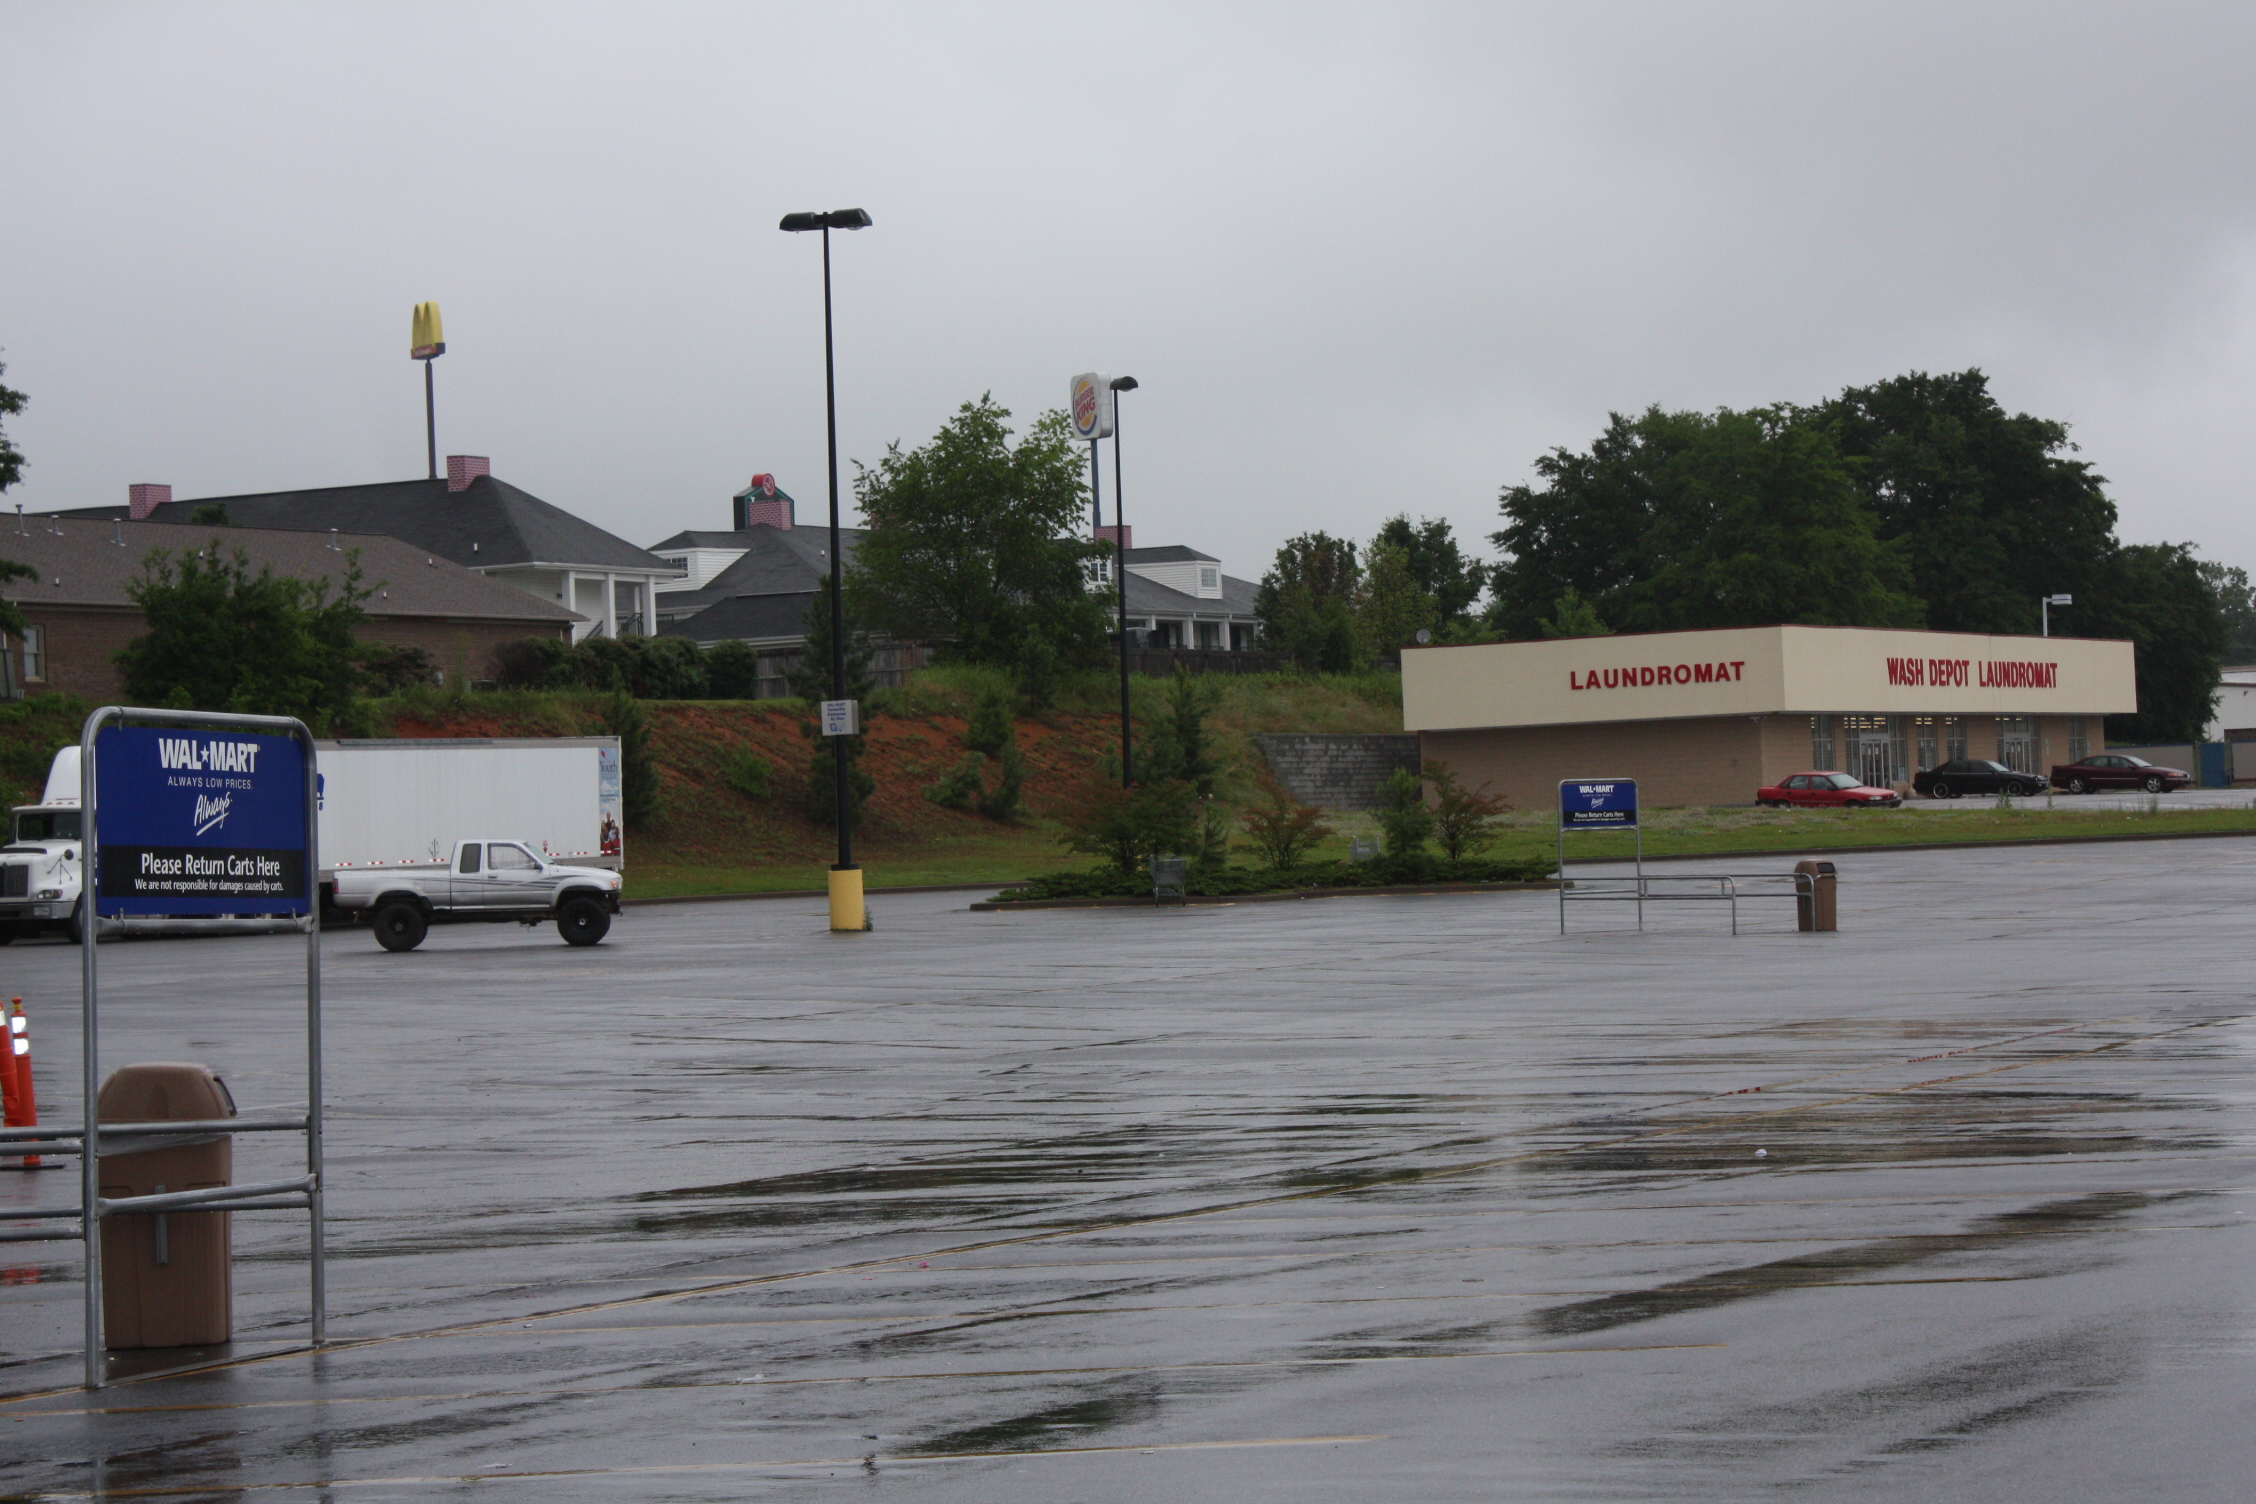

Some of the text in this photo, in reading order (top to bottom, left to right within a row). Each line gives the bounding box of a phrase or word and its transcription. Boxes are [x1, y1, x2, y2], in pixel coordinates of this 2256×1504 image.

[1076, 396, 1096, 421] KING
[1570, 661, 1745, 690] LAUNDROMAT
[1886, 657, 2058, 688] WASH DEPOT LAUNDROMAT
[167, 776, 203, 788] ALWAYS
[206, 778, 223, 788] LOW
[141, 852, 280, 876] Please Return Carts Here
[135, 878, 147, 890] We
[148, 880, 160, 890] are
[160, 880, 172, 890] not
[173, 879, 209, 893] responsible
[209, 879, 218, 891] for
[219, 880, 244, 894] damages
[244, 880, 262, 891] caused
[263, 880, 270, 894] by
